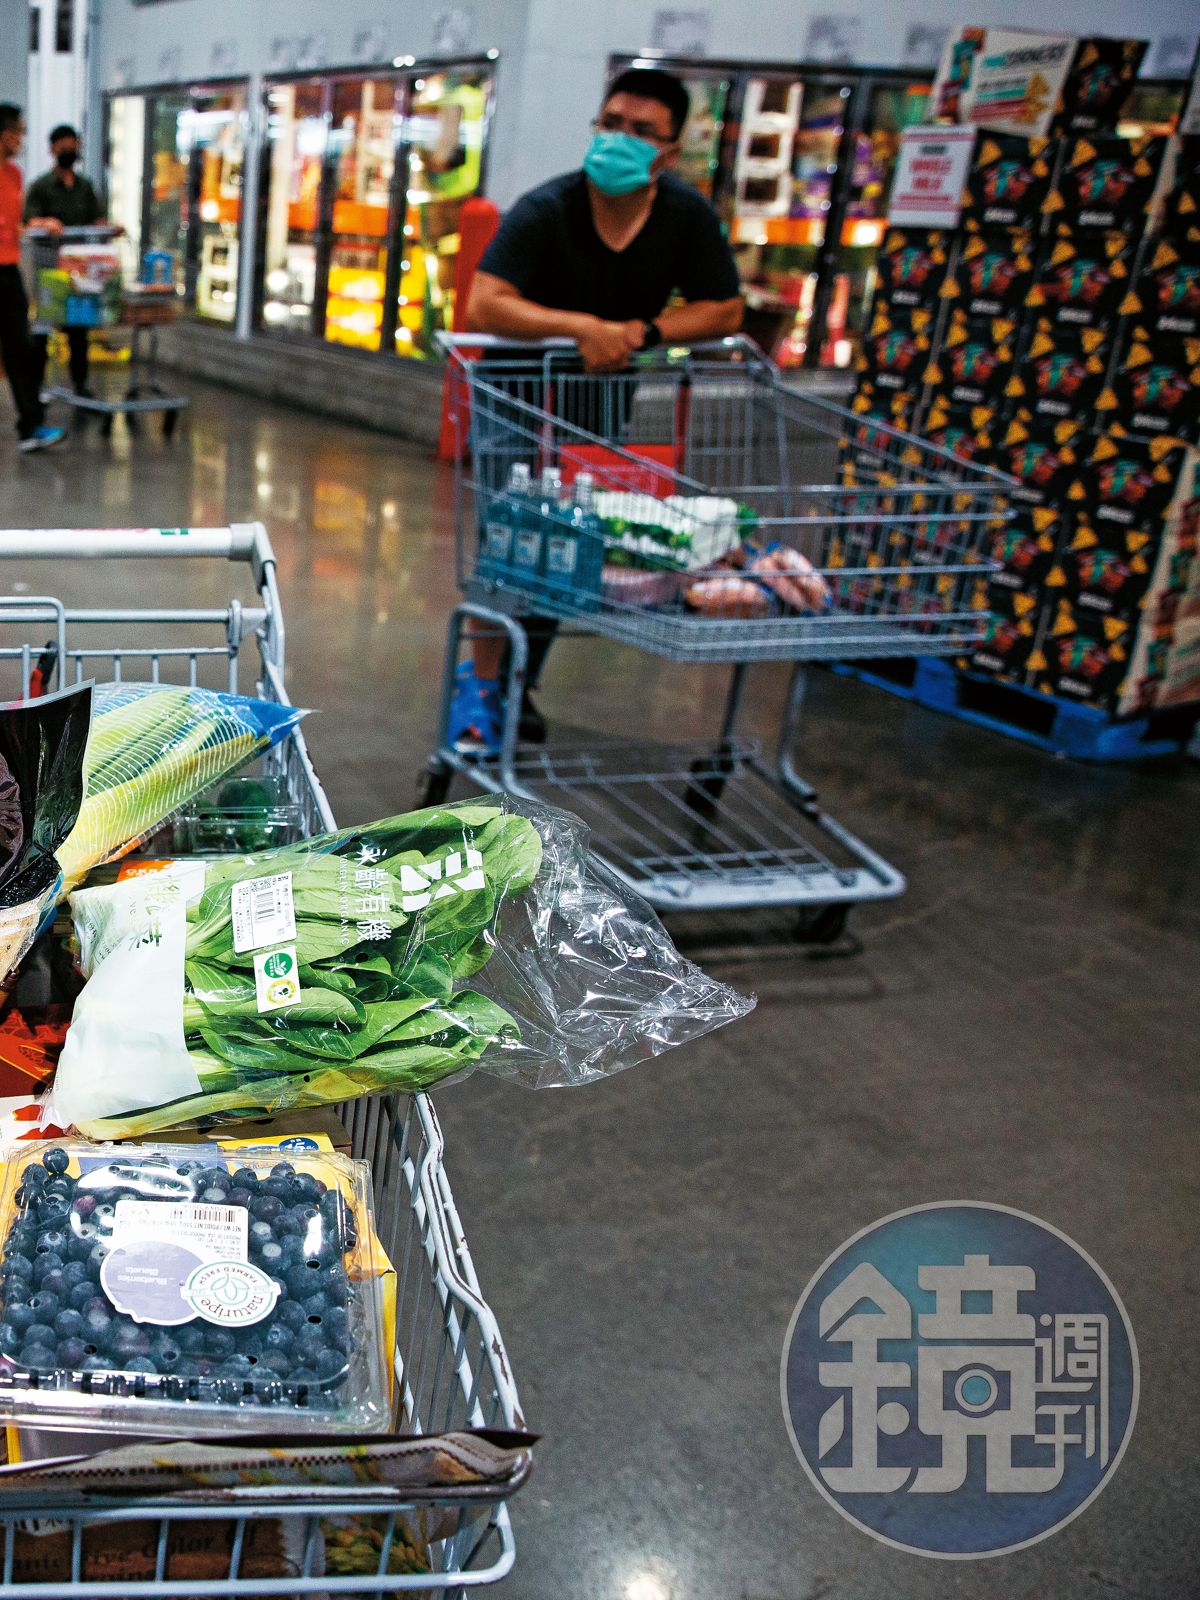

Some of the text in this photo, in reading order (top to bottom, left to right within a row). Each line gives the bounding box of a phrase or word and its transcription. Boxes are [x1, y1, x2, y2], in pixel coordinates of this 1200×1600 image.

[354, 841, 392, 942] 永齡有機
[117, 1275, 168, 1285] Blueberries
[124, 1266, 159, 1275] Bleuets
[196, 1266, 258, 1285] FARMED FRESH
[199, 1295, 264, 1319] naturipe
